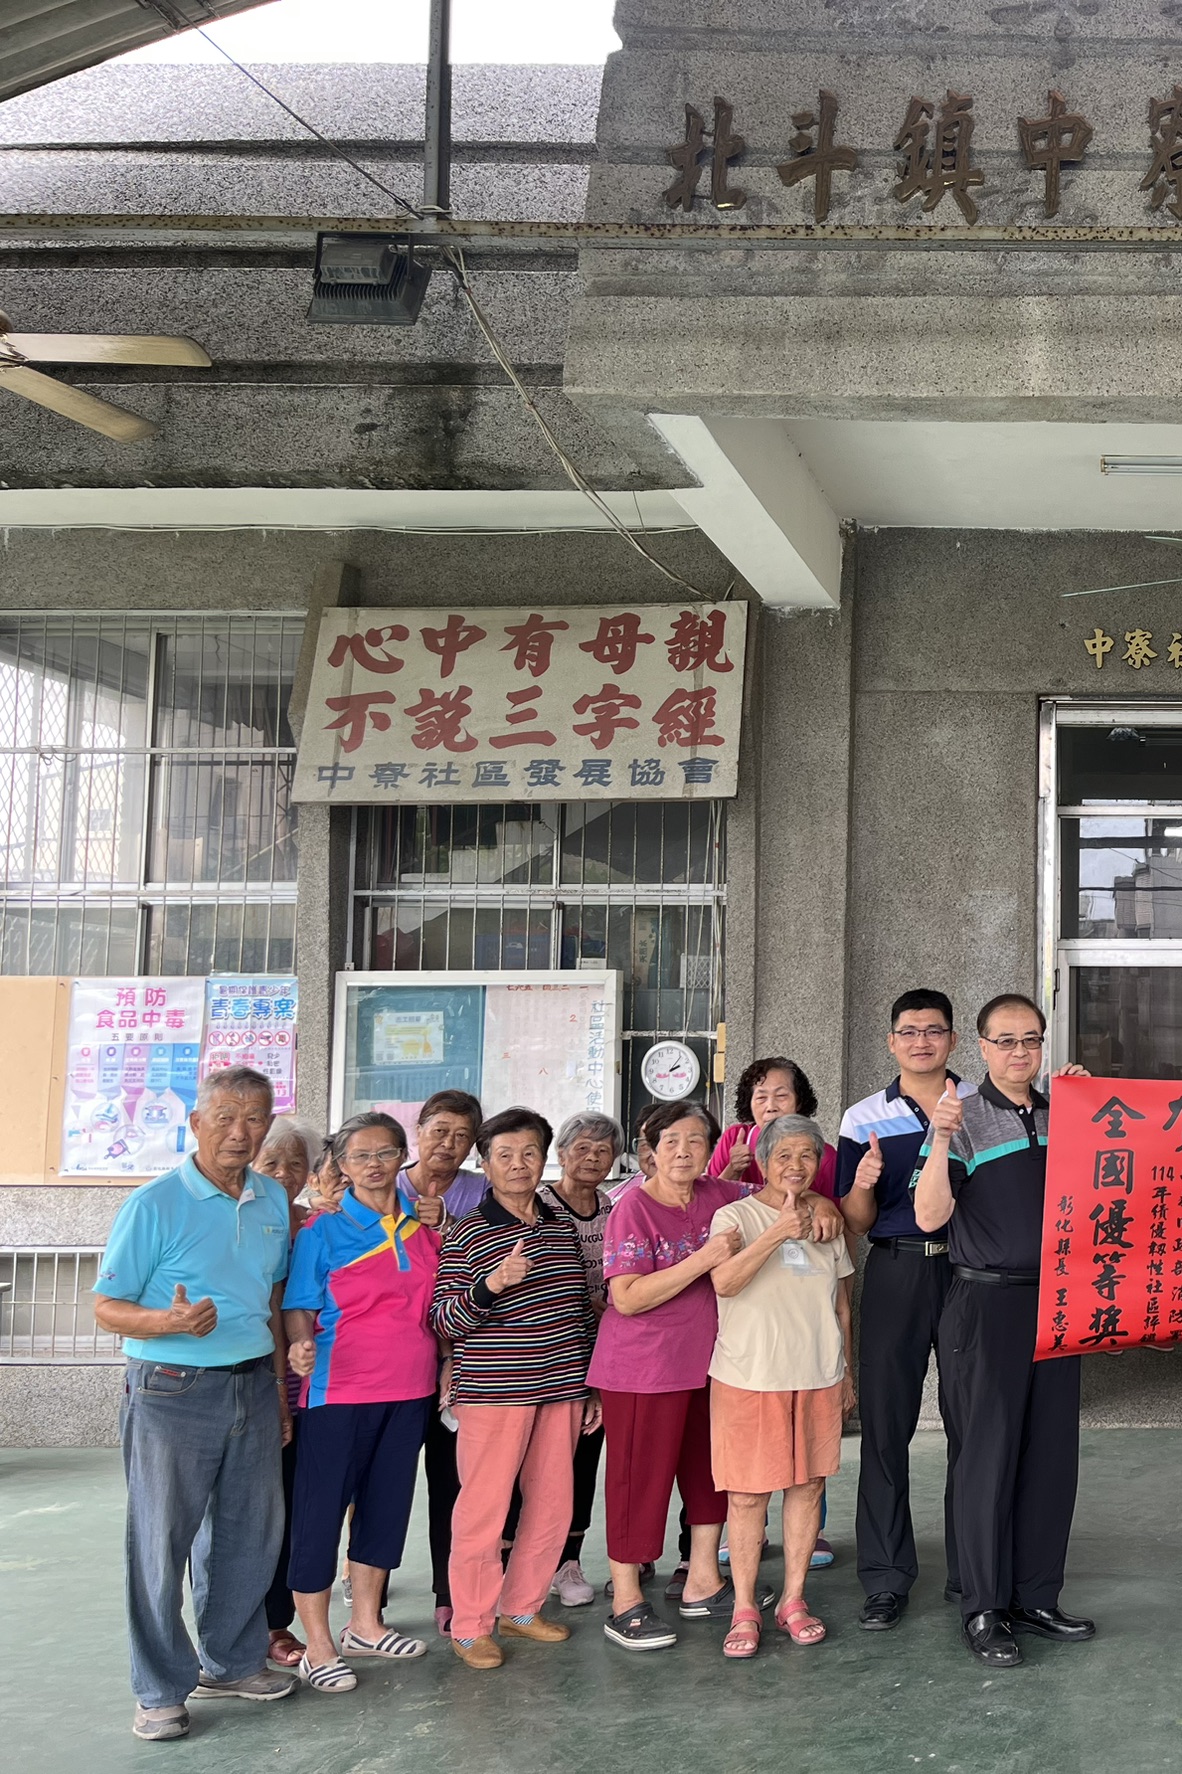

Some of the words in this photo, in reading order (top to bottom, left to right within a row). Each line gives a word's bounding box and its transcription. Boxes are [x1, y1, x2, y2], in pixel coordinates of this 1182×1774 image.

[327, 608, 735, 679] 心中有母親
[321, 684, 726, 754] 不說三字經
[316, 757, 720, 789] 中寮社區發展協會
[96, 1009, 186, 1029] 食品中毒
[115, 987, 167, 1007] 預防
[211, 998, 296, 1019] 青春專案
[111, 1032, 164, 1041] 五要原則
[1054, 1195, 1074, 1277] 彰化縣長
[1079, 1096, 1146, 1346] 全國優等獎
[1048, 1287, 1070, 1352] 王惠美
